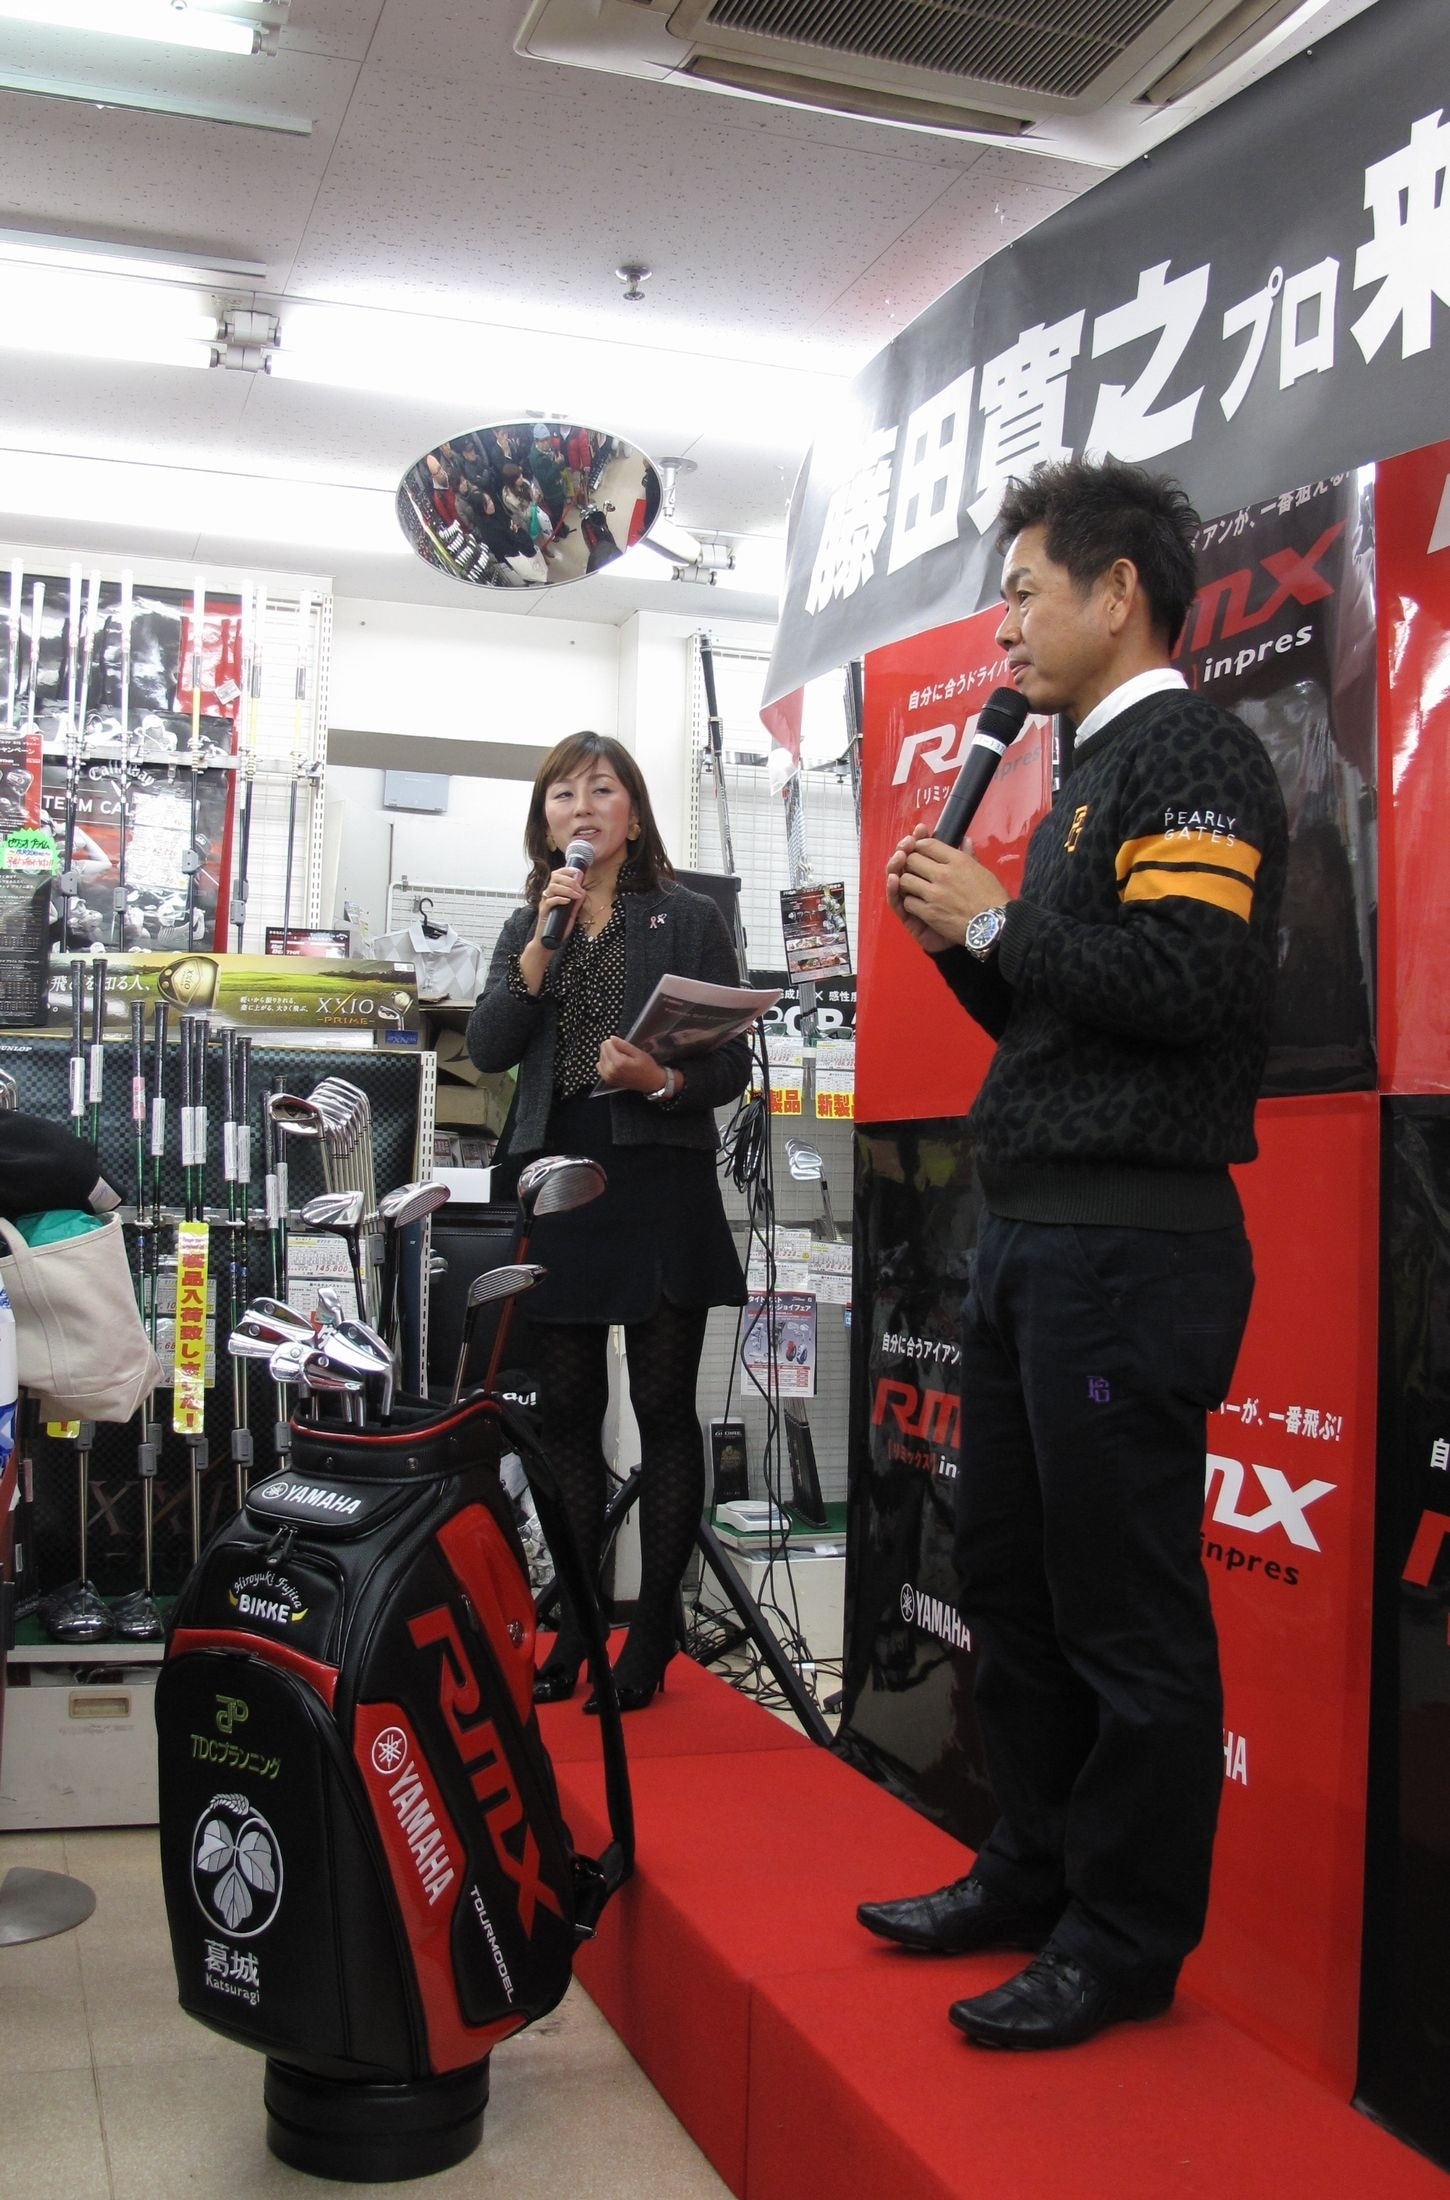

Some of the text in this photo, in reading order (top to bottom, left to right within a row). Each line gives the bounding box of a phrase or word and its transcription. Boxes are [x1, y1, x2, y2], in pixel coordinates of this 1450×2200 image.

[1203, 624, 1313, 683] inpres
[1164, 808, 1237, 830] PEARLY
[1164, 826, 1236, 847] GATES
[316, 992, 374, 1015] XXIO
[882, 1332, 961, 1366] 自分に合うアイアン
[284, 1484, 362, 1515] YAMAHA
[234, 1570, 302, 1609] Hiroyuki Fujita
[238, 1594, 291, 1625] BIKKE
[916, 1590, 971, 1652] YAMAHA
[387, 1761, 456, 1906] YAMAHA
[204, 1938, 260, 1987] 葛城
[205, 1972, 260, 2007] Katsuragi
